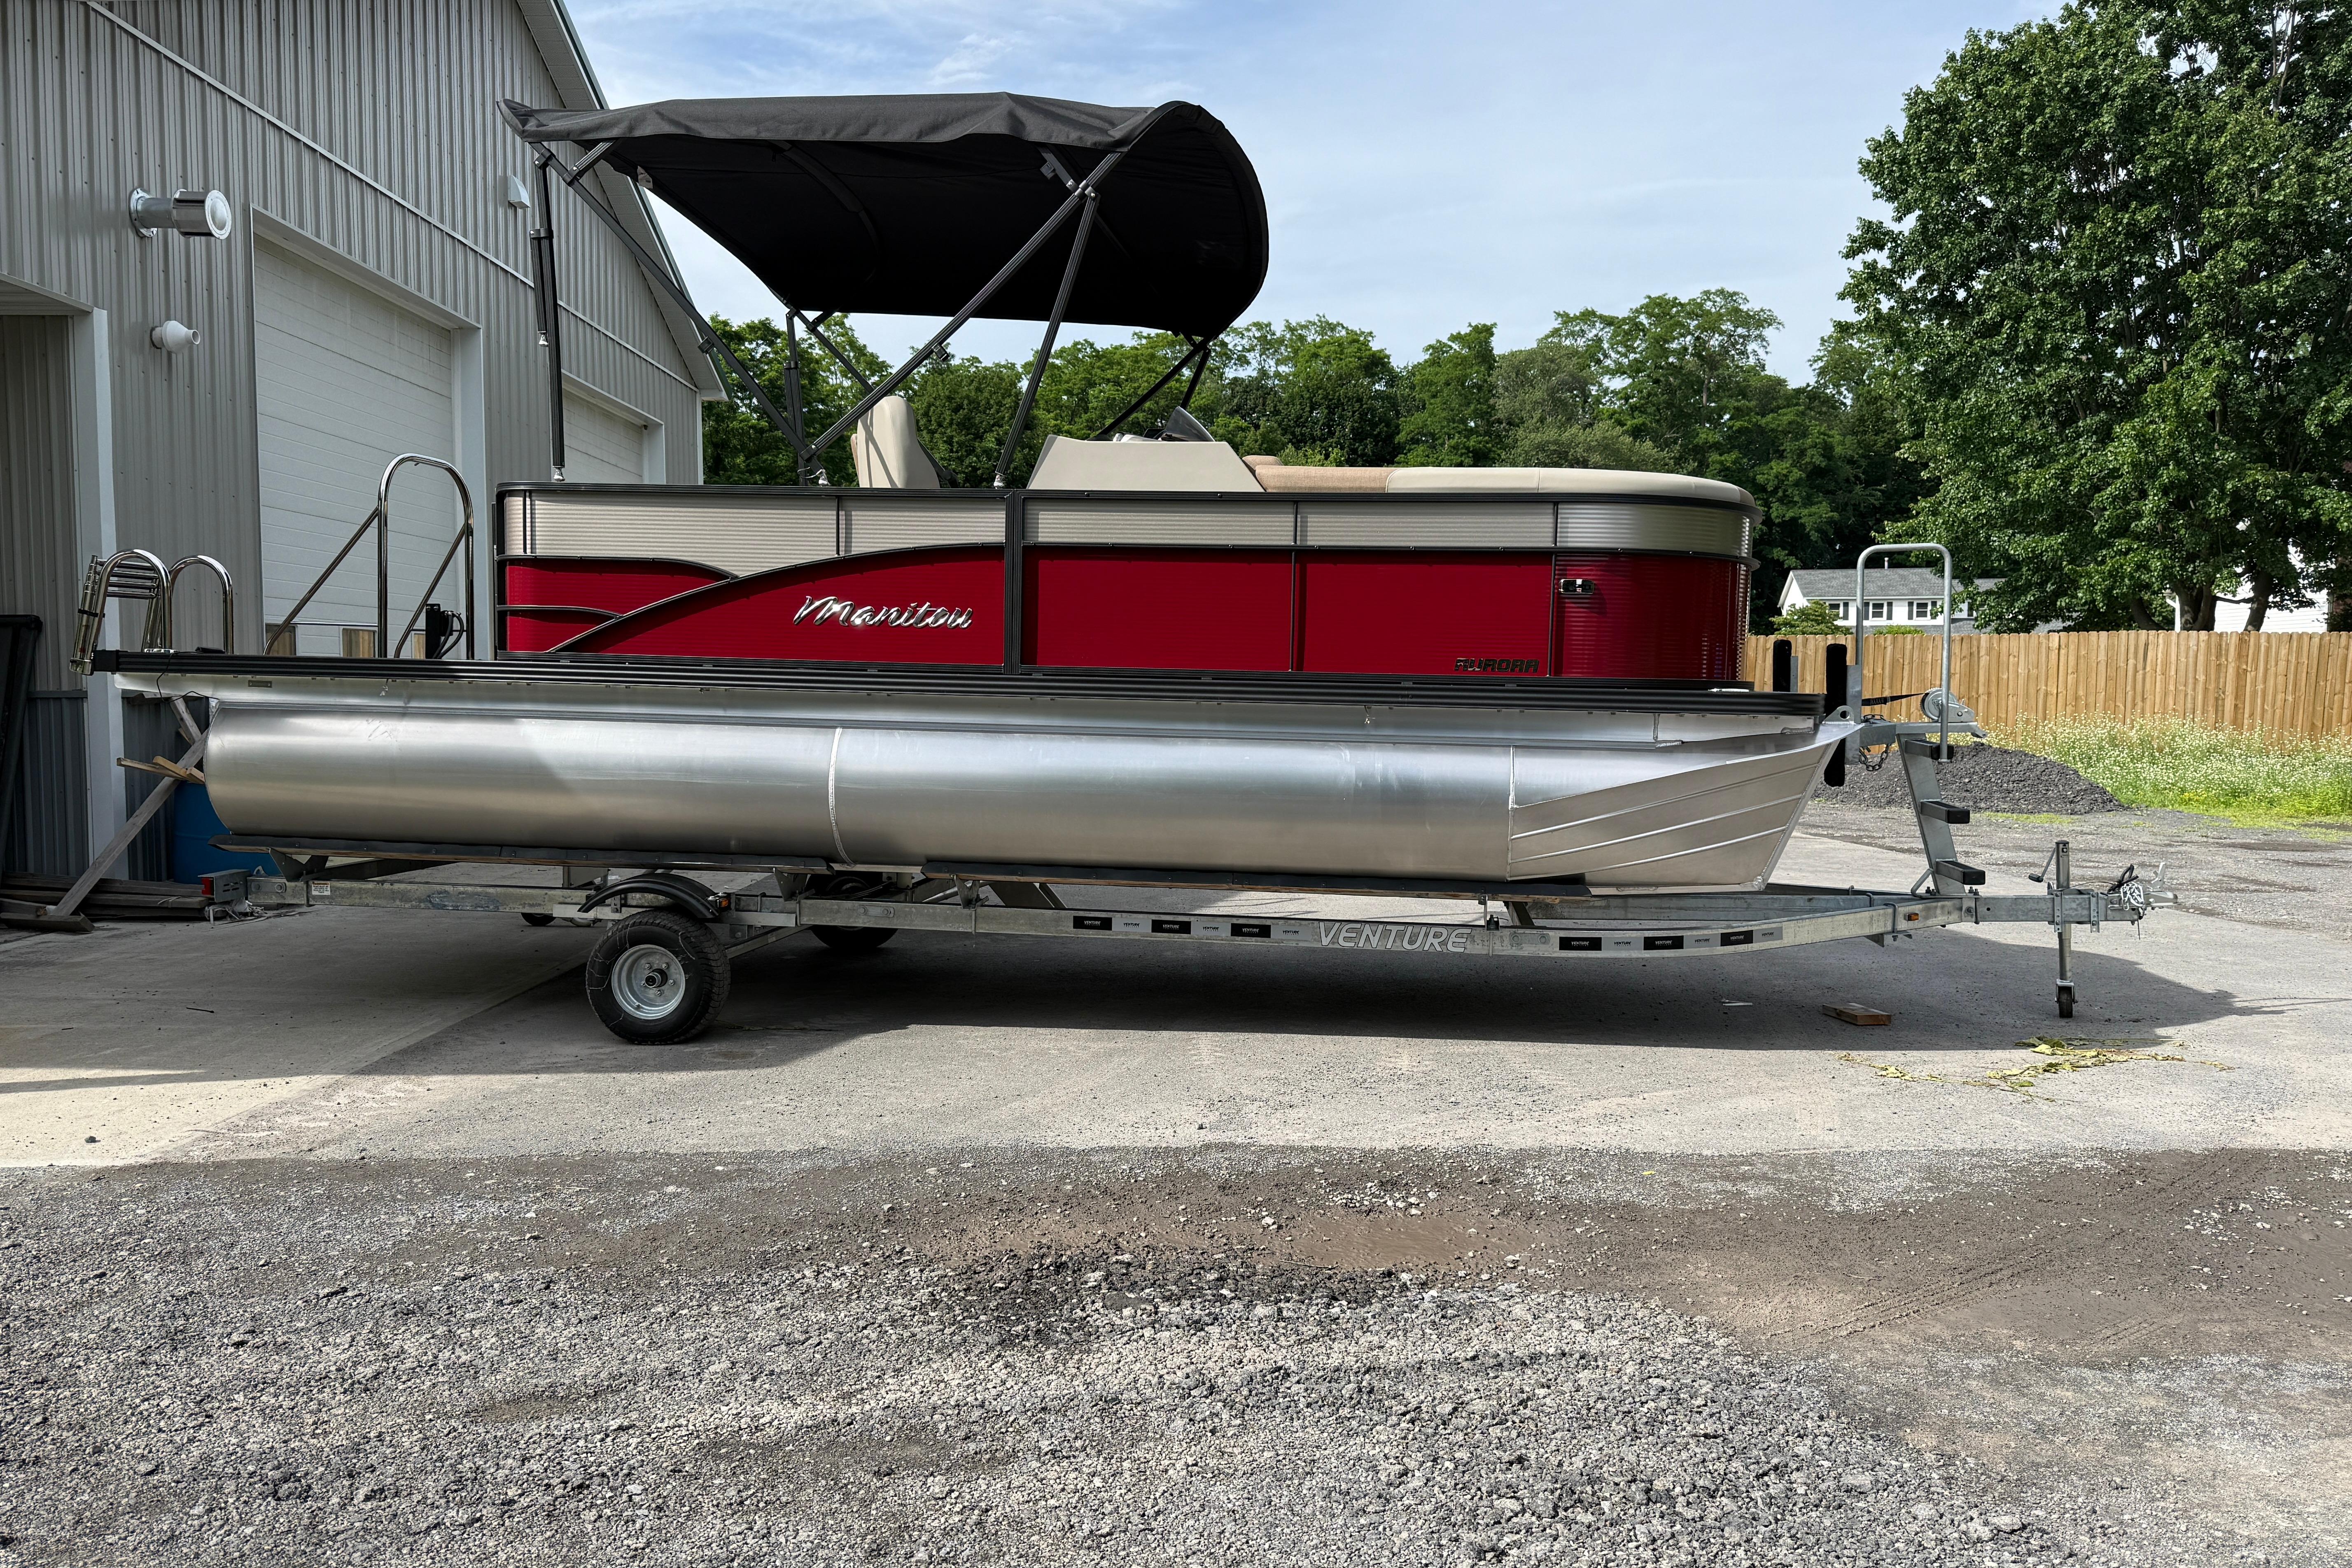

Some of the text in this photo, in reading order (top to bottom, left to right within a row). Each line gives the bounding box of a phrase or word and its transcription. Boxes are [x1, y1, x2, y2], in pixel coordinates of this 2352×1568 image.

[793, 596, 972, 628] Manitou
[1455, 658, 1539, 673] AURORA
[1319, 922, 1472, 952] VENTURE
